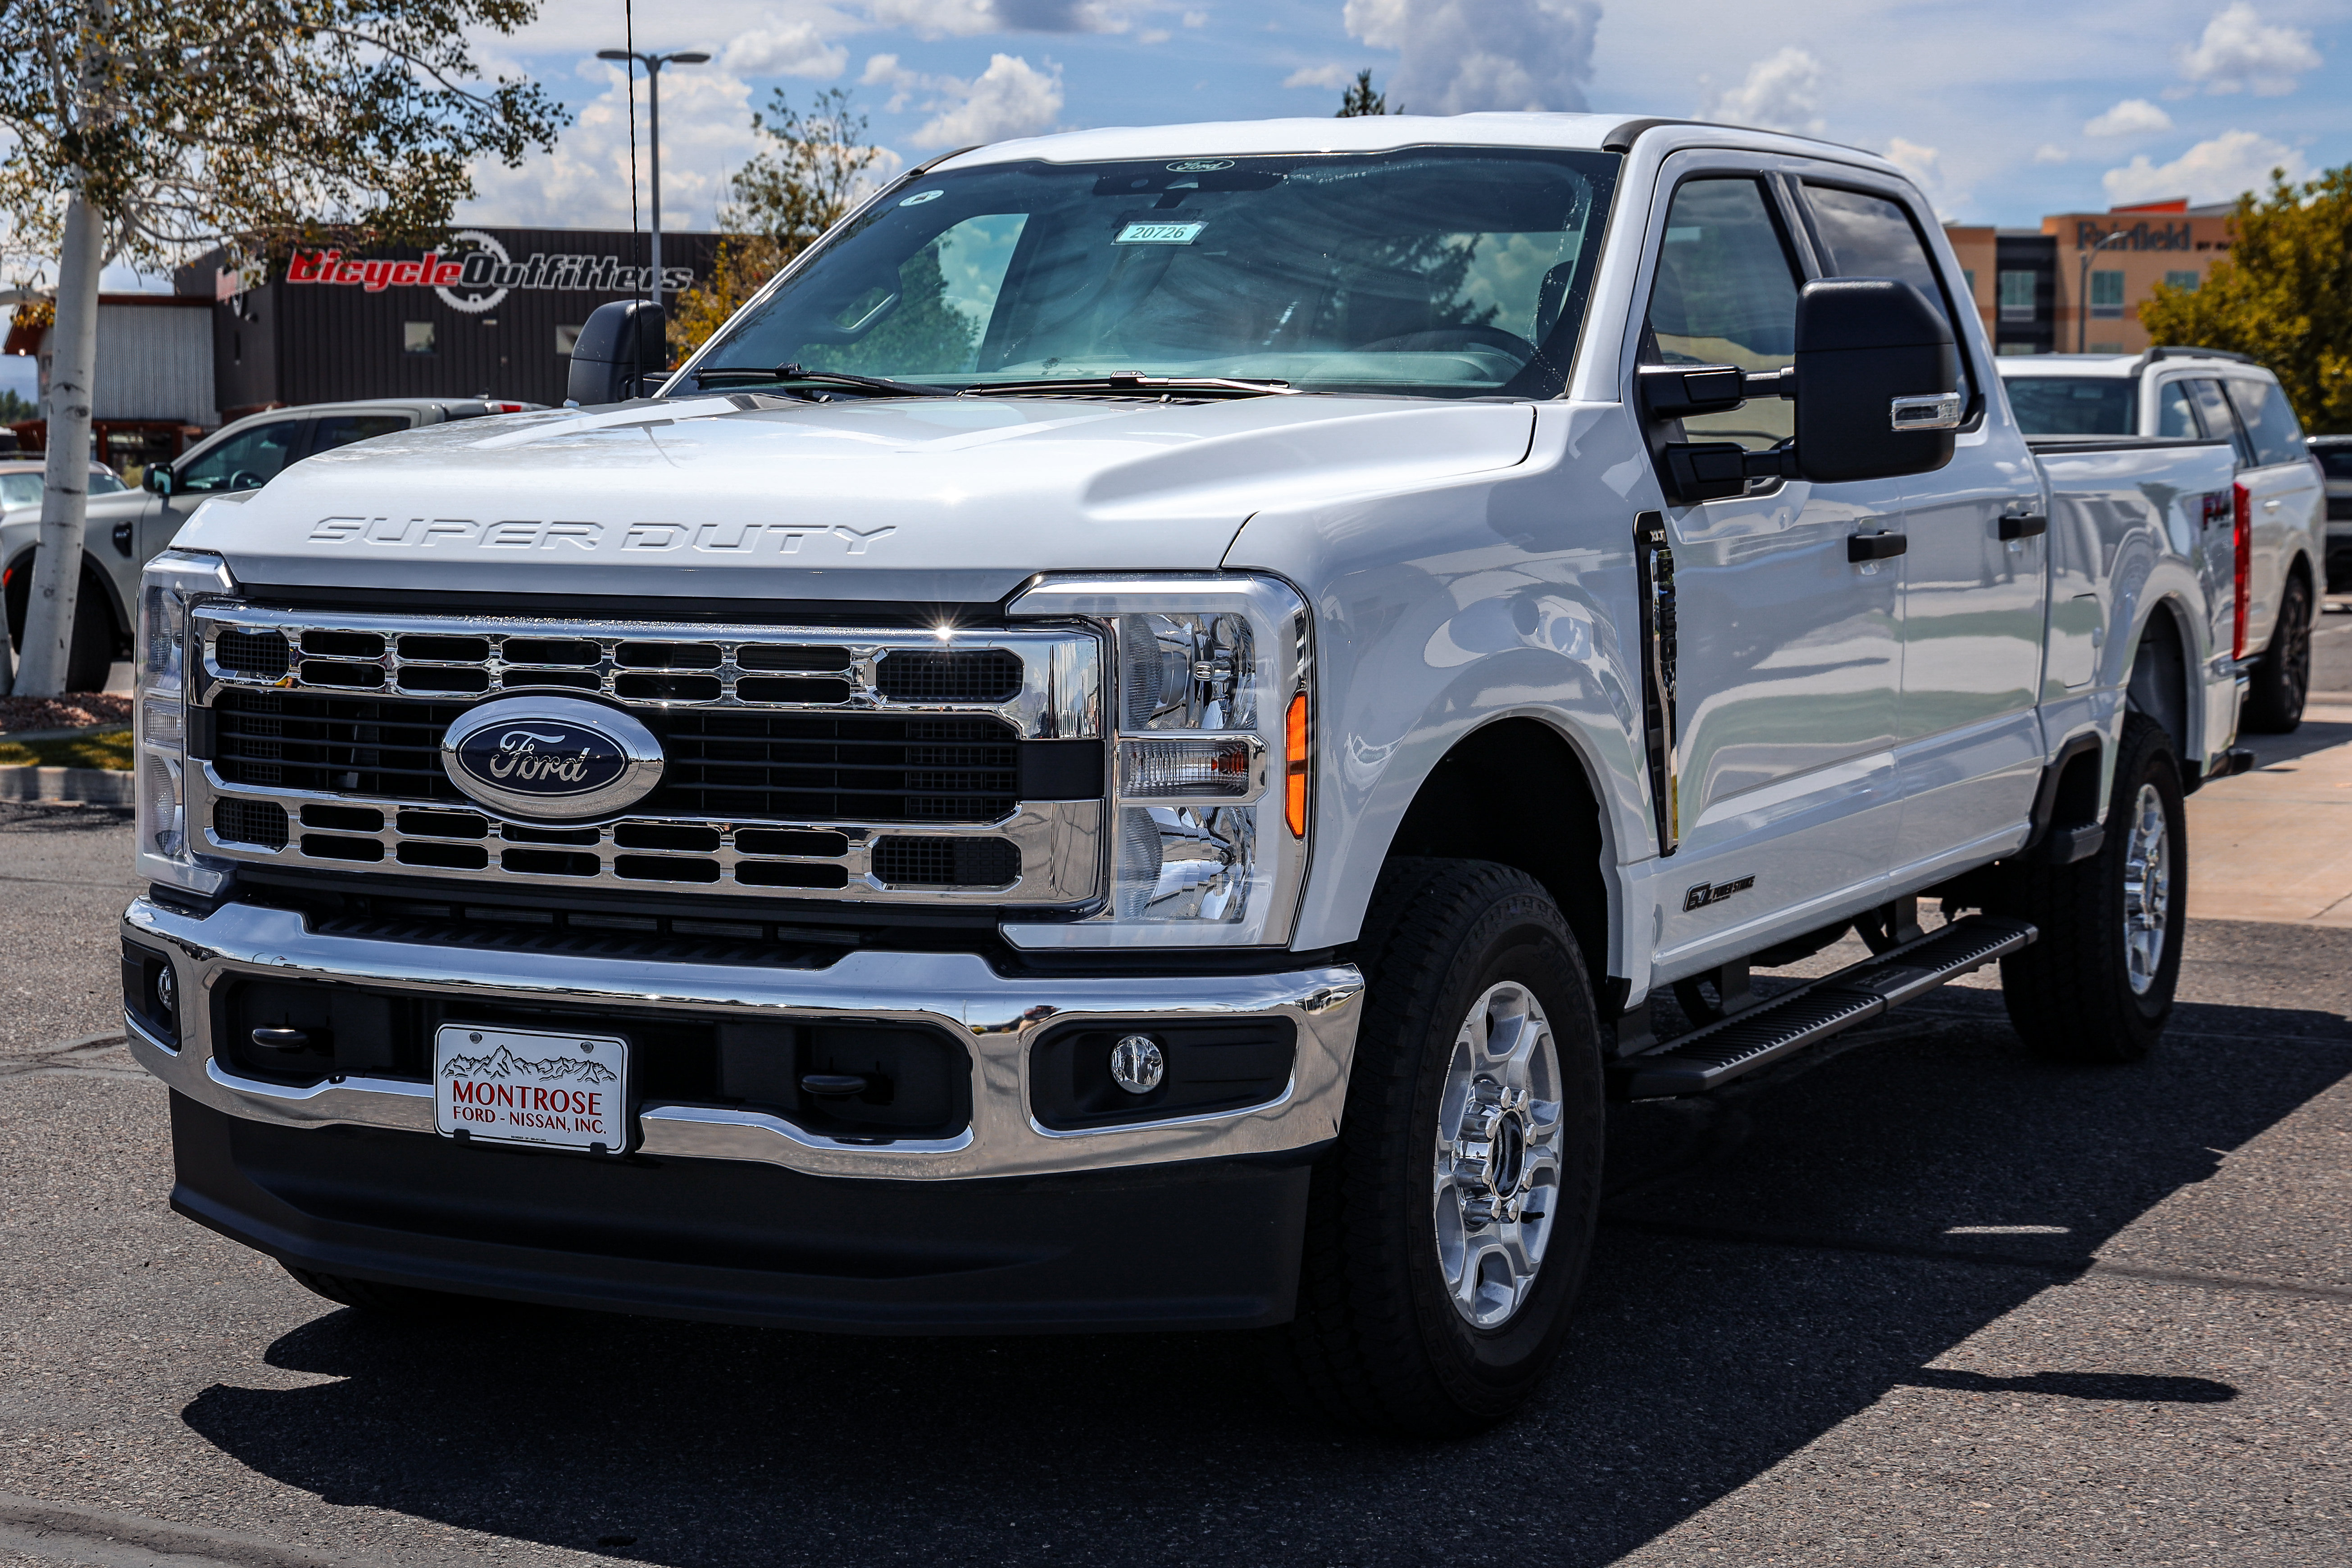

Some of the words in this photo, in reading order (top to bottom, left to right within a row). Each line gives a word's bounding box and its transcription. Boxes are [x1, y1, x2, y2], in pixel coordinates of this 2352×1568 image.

[1176, 160, 1224, 170] Ford
[1129, 226, 1187, 239] 20726
[2077, 221, 2191, 251] Fairfield
[286, 248, 463, 292] Bicycle
[308, 517, 605, 550] SUPER
[620, 523, 897, 555] DUTY
[1650, 529, 1666, 542] XLT
[490, 731, 591, 782] Ford
[1732, 875, 1755, 893] STROKE
[453, 1080, 602, 1116] MONTROSE
[453, 1106, 496, 1123] FORD
[510, 1112, 571, 1134] NISSAN,
[575, 1118, 607, 1134] INC.
